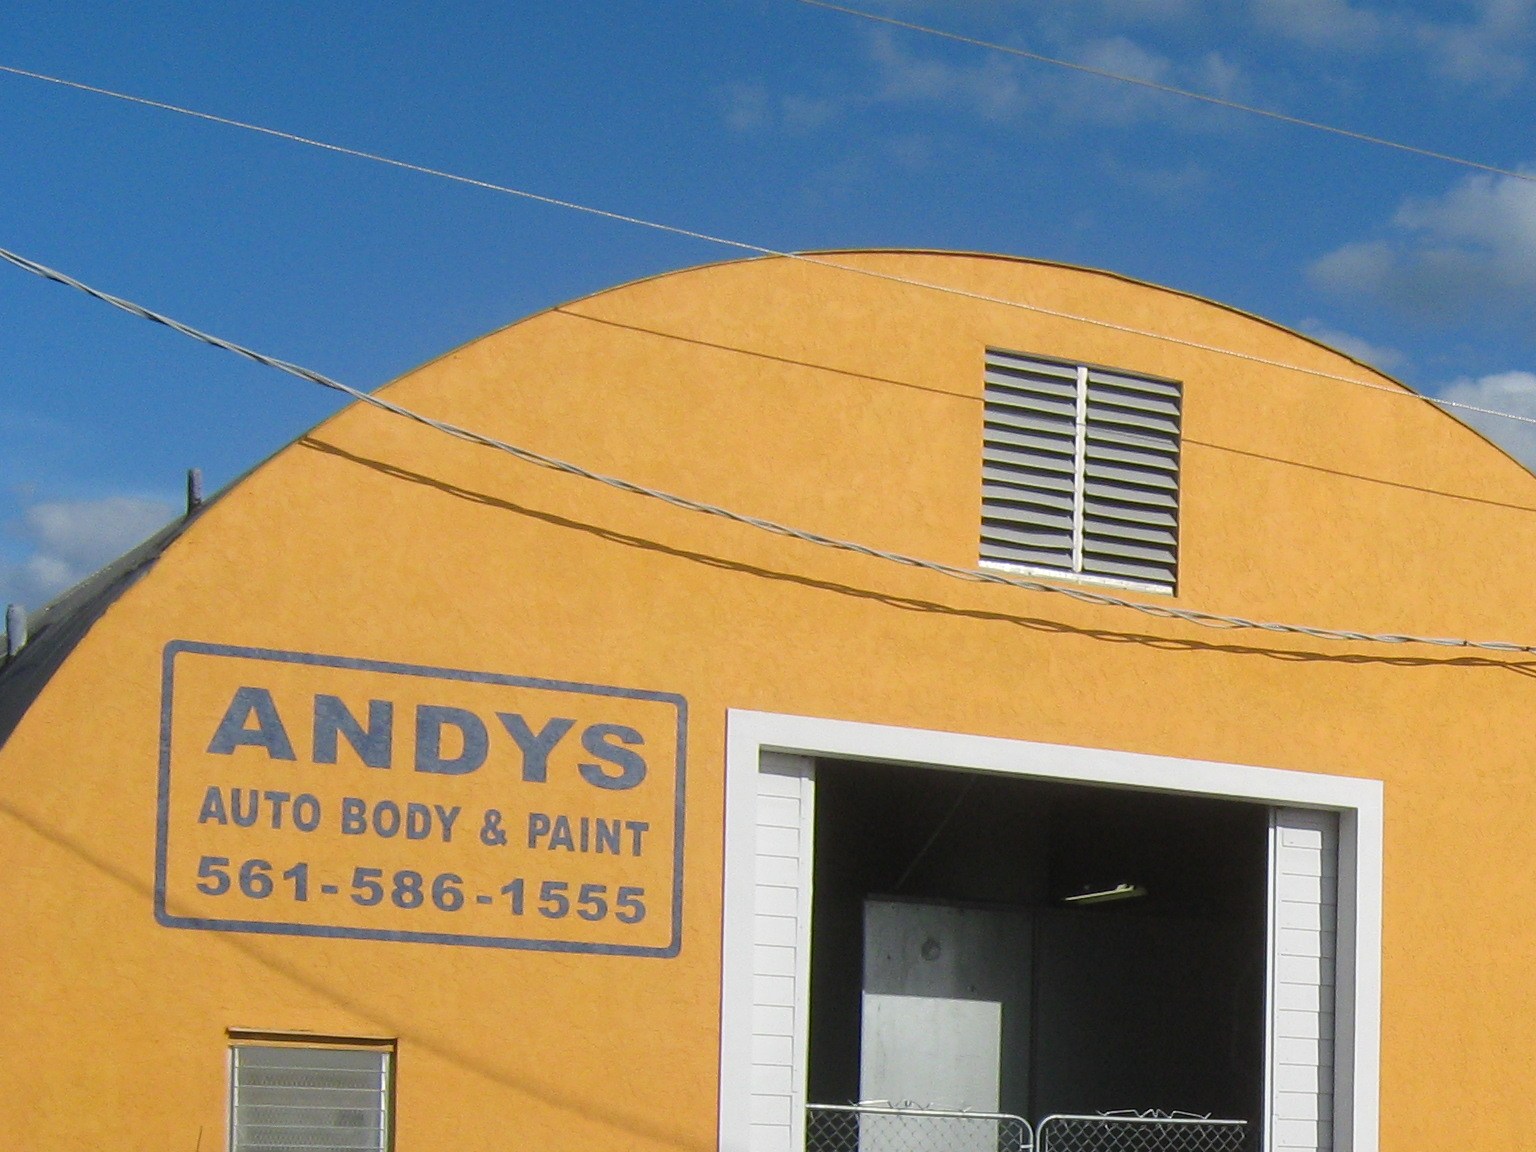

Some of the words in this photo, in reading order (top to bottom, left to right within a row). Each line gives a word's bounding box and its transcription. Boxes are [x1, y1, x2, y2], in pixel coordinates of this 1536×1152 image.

[207, 686, 648, 791] ANDYS
[200, 786, 321, 832] AUTO
[341, 797, 463, 843] BODY
[480, 809, 508, 846] &
[528, 813, 650, 857] PAINT
[196, 855, 647, 924] 561-586-1555
